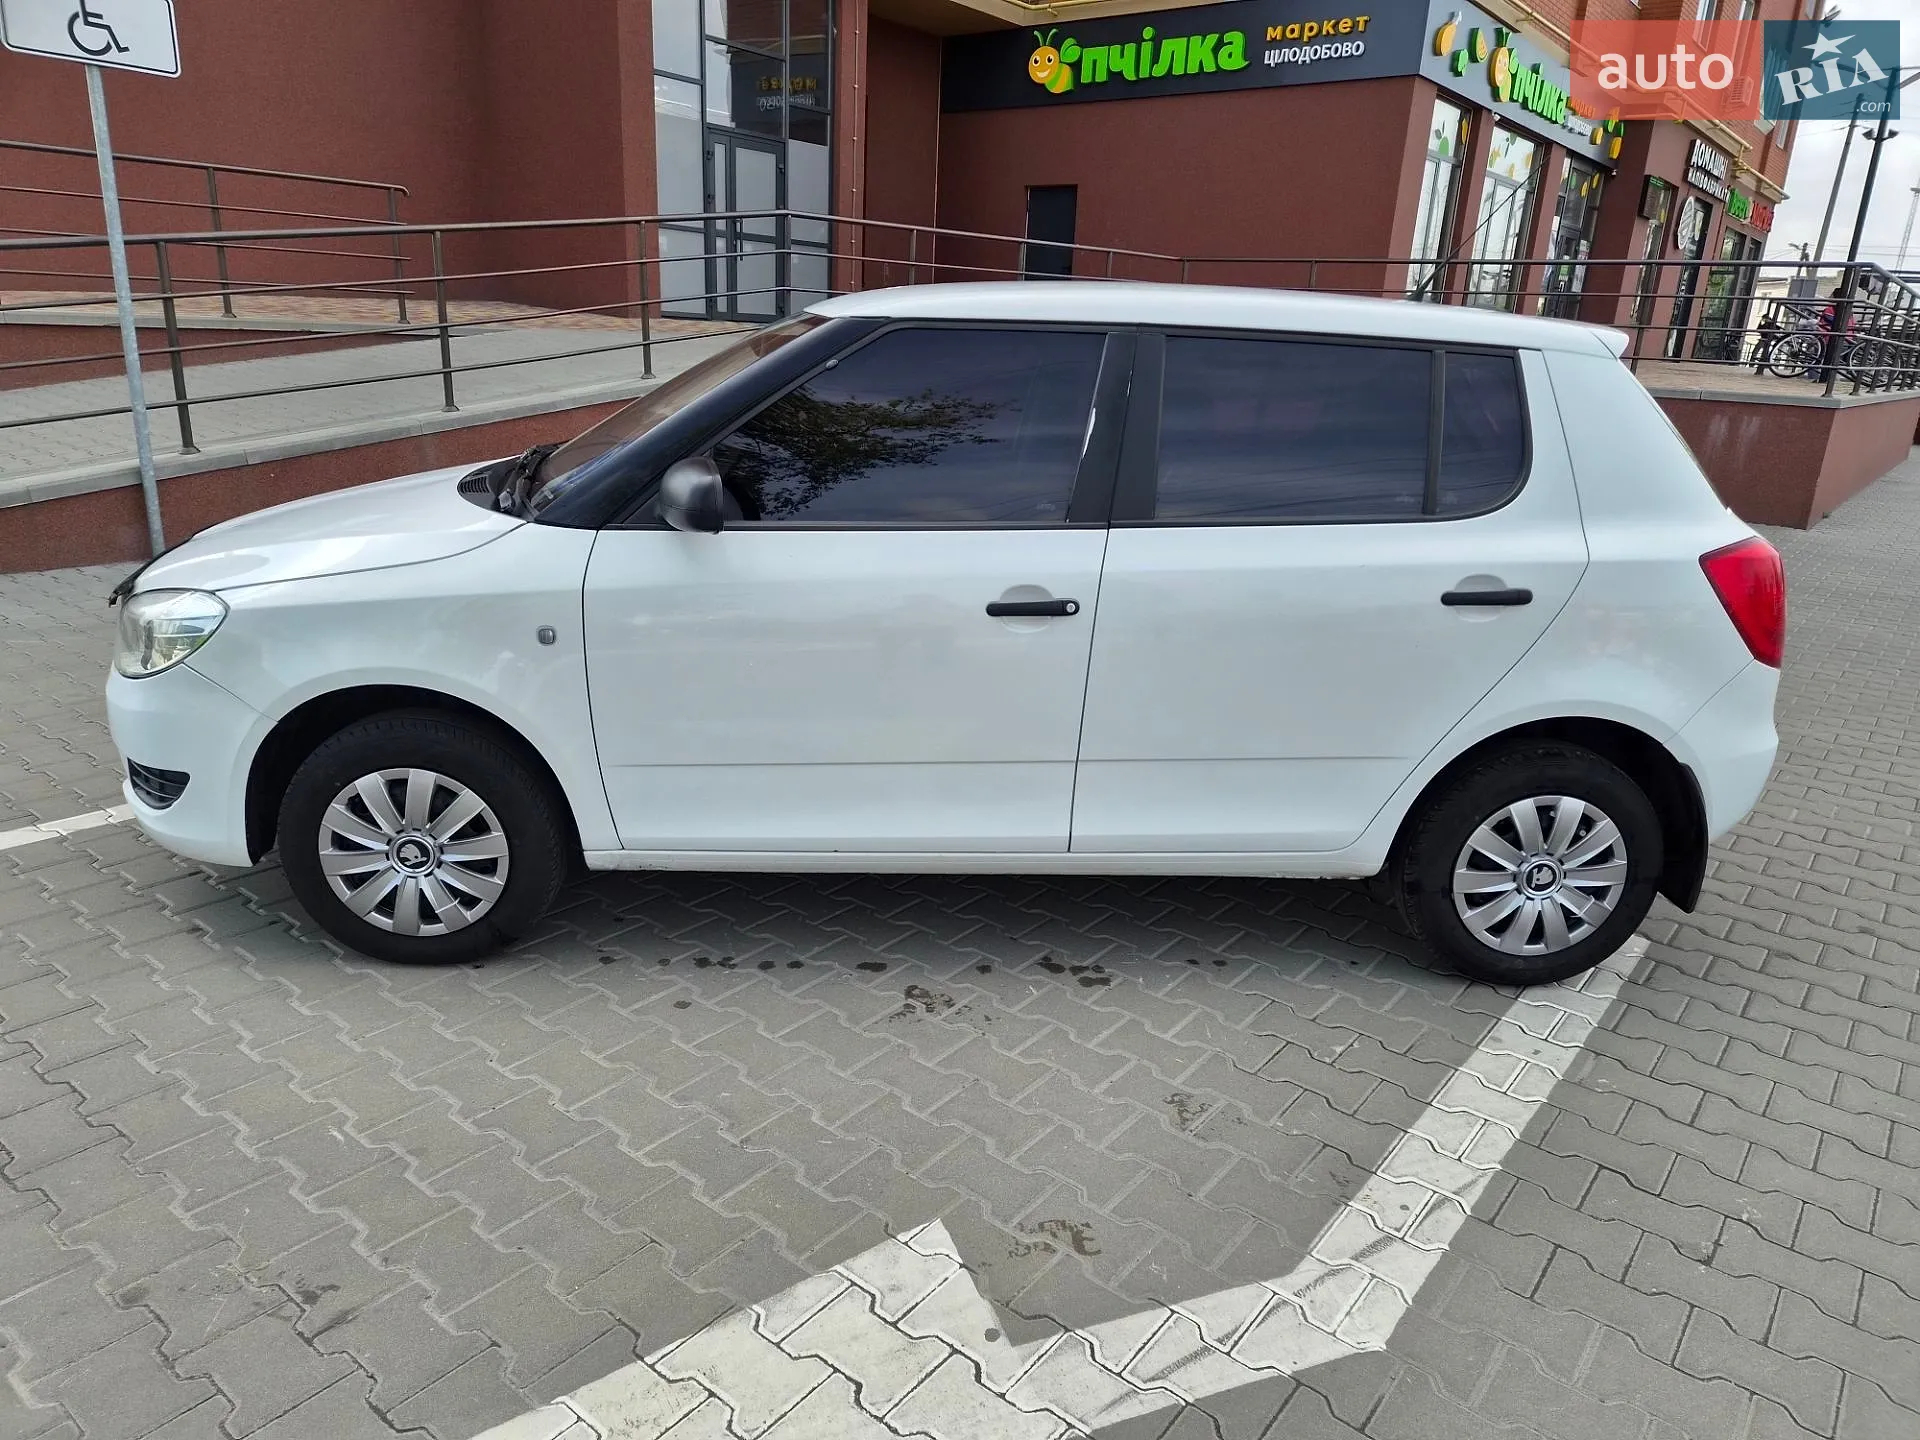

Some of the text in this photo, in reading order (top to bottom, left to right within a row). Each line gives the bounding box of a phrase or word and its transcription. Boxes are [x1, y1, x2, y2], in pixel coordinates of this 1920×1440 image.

[1265, 14, 1371, 42] маркет
[1080, 26, 1251, 84] пчілка
[1264, 40, 1366, 67] ЦІЛОДОБОВО
